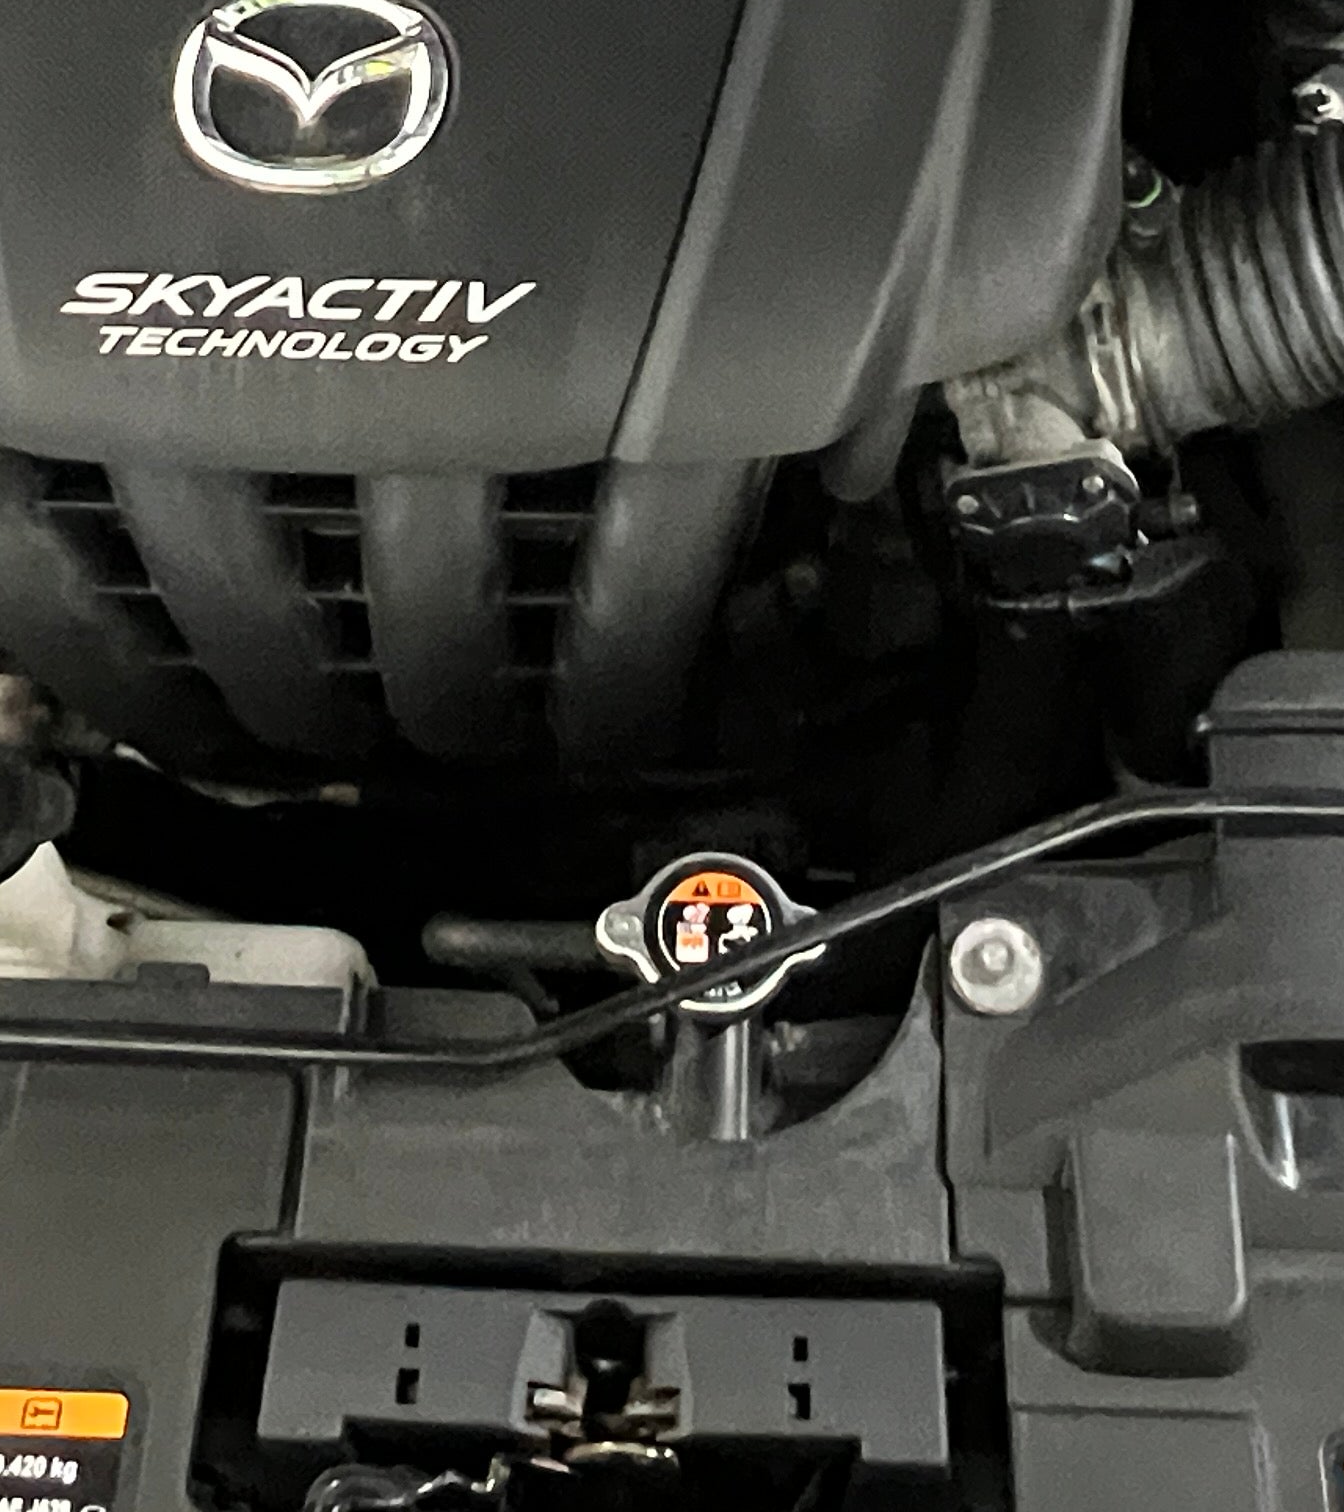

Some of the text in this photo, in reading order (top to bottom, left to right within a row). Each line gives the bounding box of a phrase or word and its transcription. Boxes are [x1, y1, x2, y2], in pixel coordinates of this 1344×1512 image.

[60, 273, 536, 323] SKYACTIV
[98, 324, 488, 362] TECHNOLOGY
[50, 1457, 78, 1484] kg
